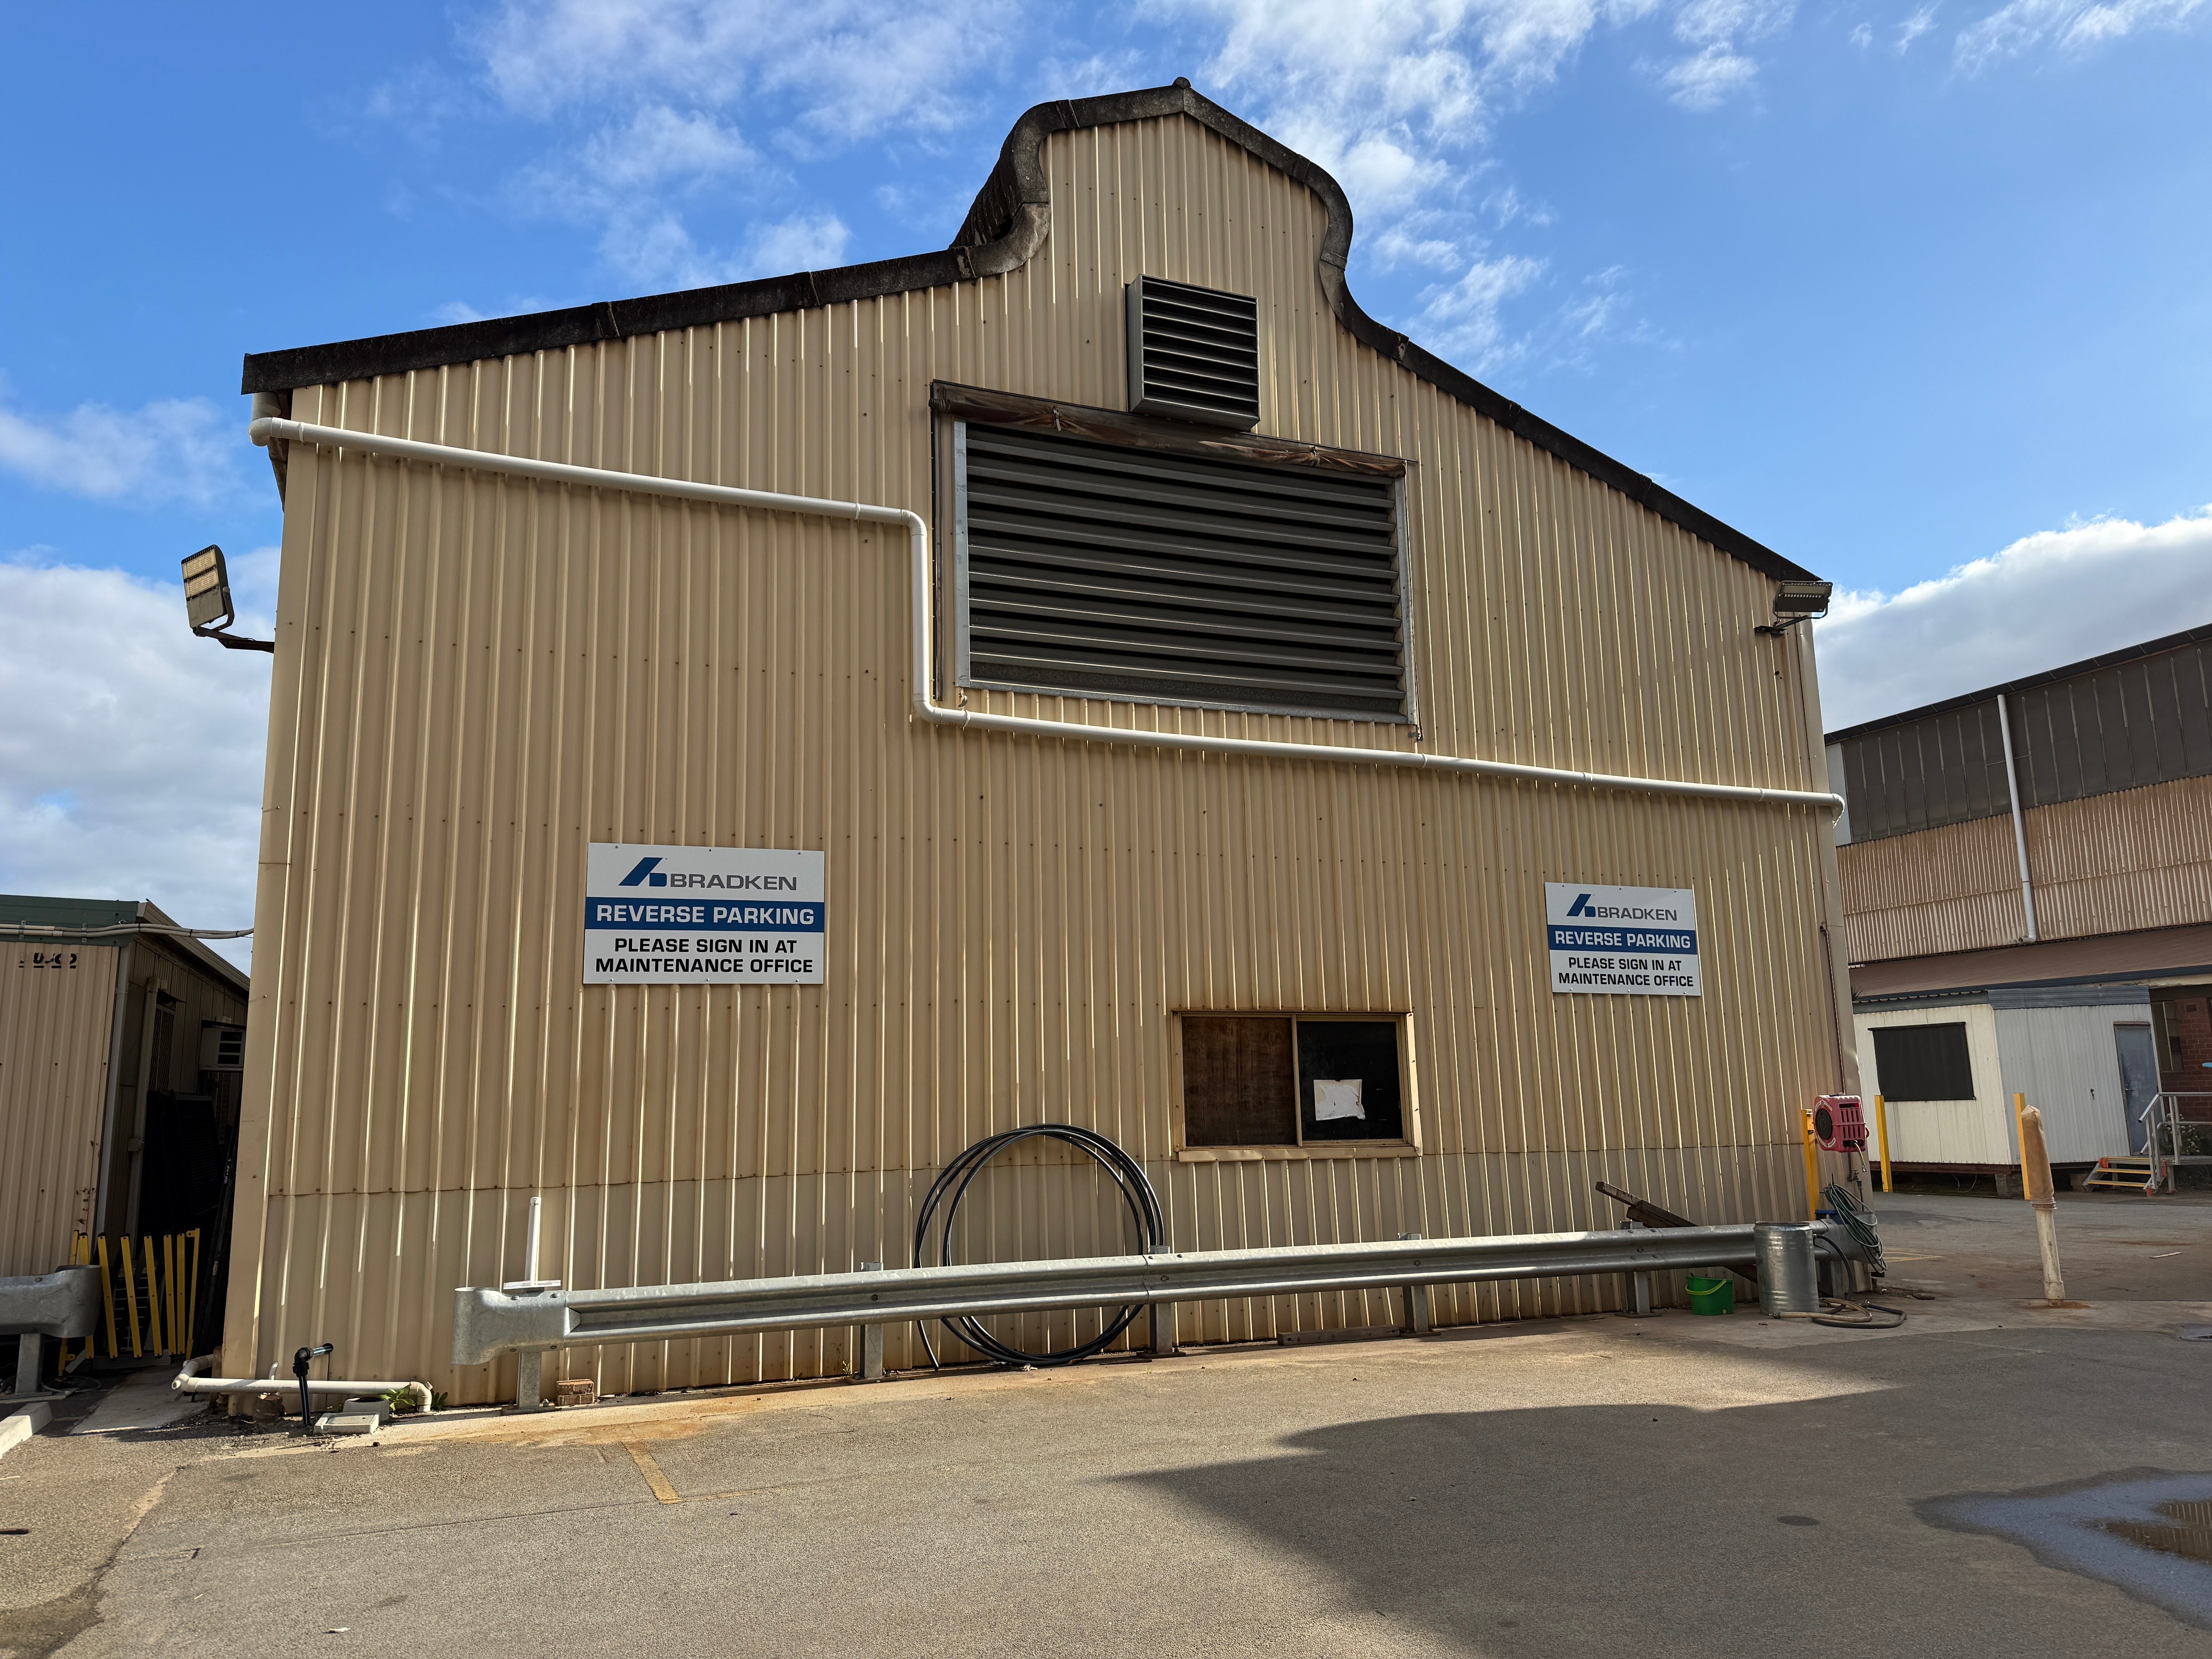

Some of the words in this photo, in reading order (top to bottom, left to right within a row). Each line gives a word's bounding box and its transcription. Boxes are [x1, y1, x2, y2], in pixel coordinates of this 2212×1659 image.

[670, 874, 797, 890] BRADKEN
[597, 905, 704, 922] REVERSE
[713, 907, 814, 924] PARKING
[1597, 907, 1677, 921] BRADKEN
[615, 938, 689, 952] PLEASE
[696, 939, 742, 953] SIGN
[749, 940, 768, 953] IN
[775, 940, 797, 953] AT
[1555, 931, 1622, 946] REVERSE
[1627, 933, 1690, 948] PARKING
[596, 958, 743, 972] MAINTENANCE
[751, 959, 813, 973] OFFICE
[1569, 957, 1615, 969] PLEASE
[1619, 958, 1647, 970] SIGN
[1652, 960, 1664, 970] IN
[1668, 960, 1681, 971] AT
[1559, 973, 1650, 986] MAINTENANCE
[1654, 975, 1693, 986] OFFICE
